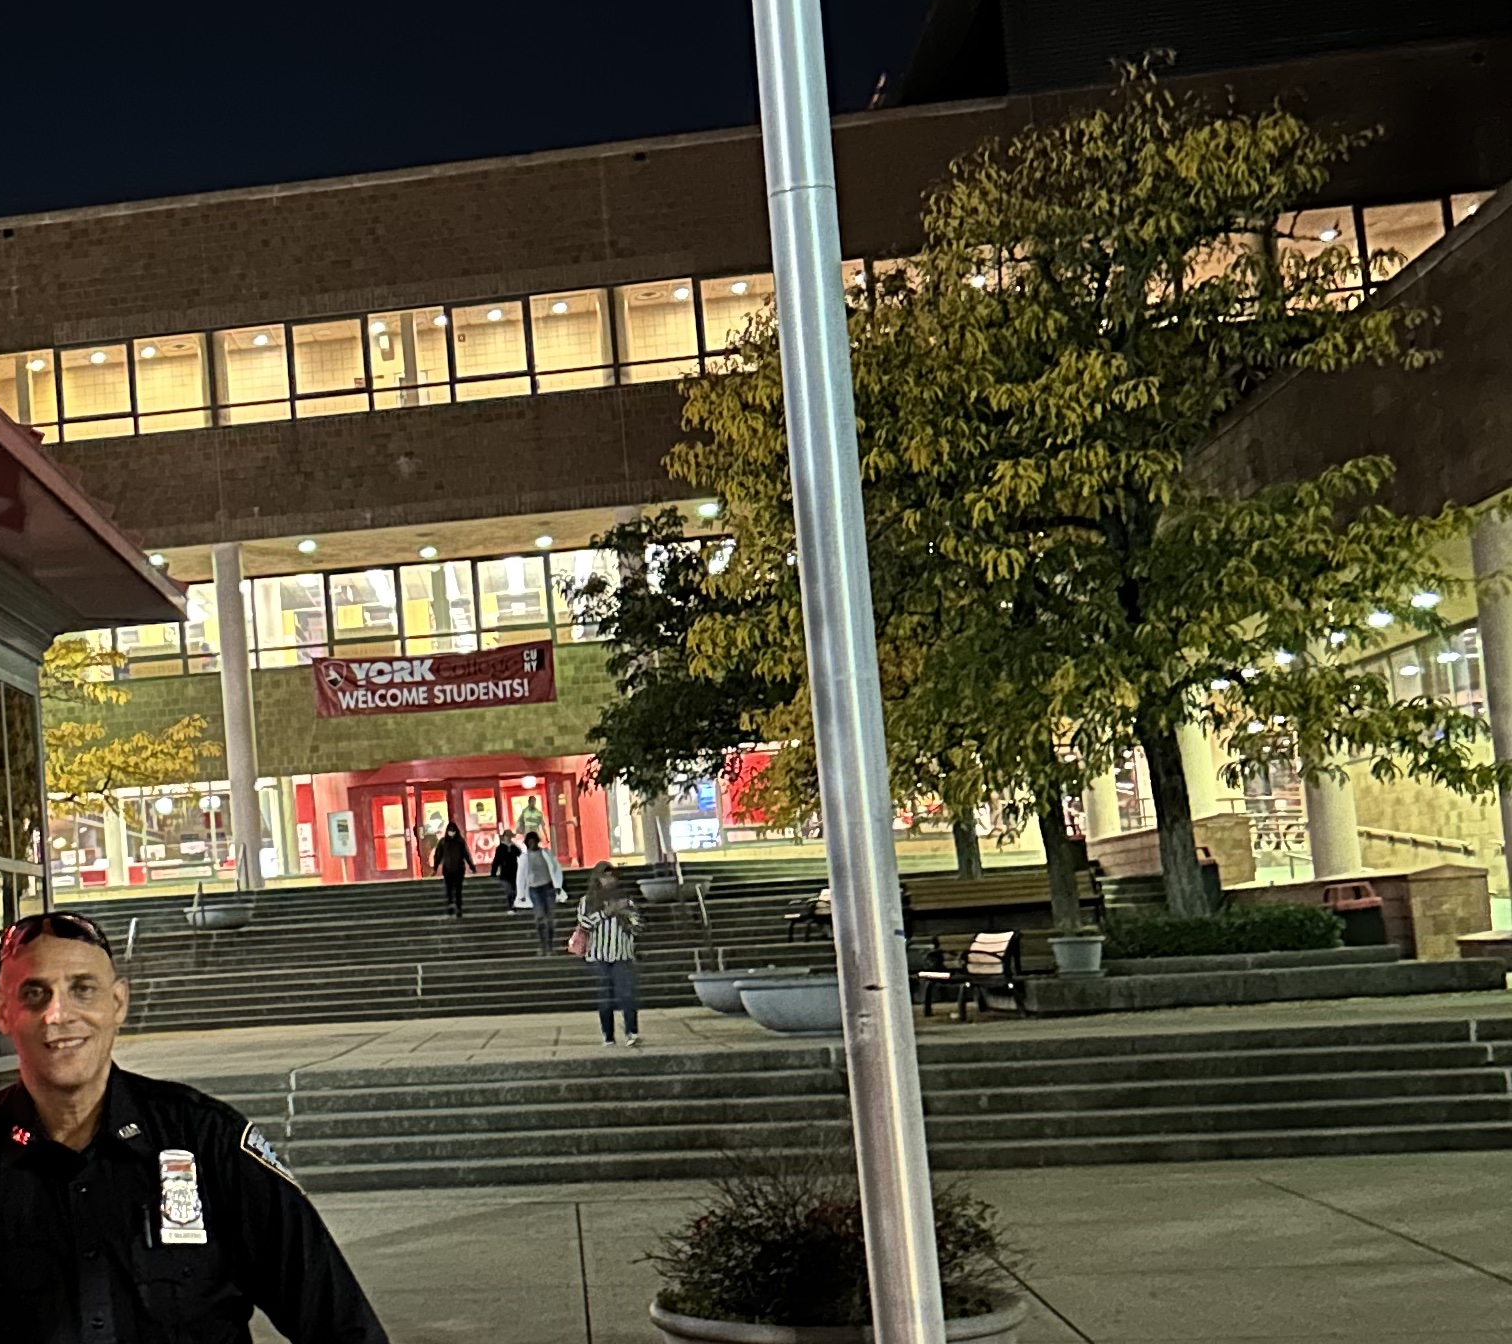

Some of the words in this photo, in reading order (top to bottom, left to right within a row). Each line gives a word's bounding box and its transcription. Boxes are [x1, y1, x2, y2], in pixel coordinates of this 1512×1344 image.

[523, 649, 537, 661] CU
[351, 658, 436, 686] YORK
[523, 661, 538, 673] NY
[338, 687, 428, 710] WELCOME
[433, 678, 530, 705] STUDENTS!
